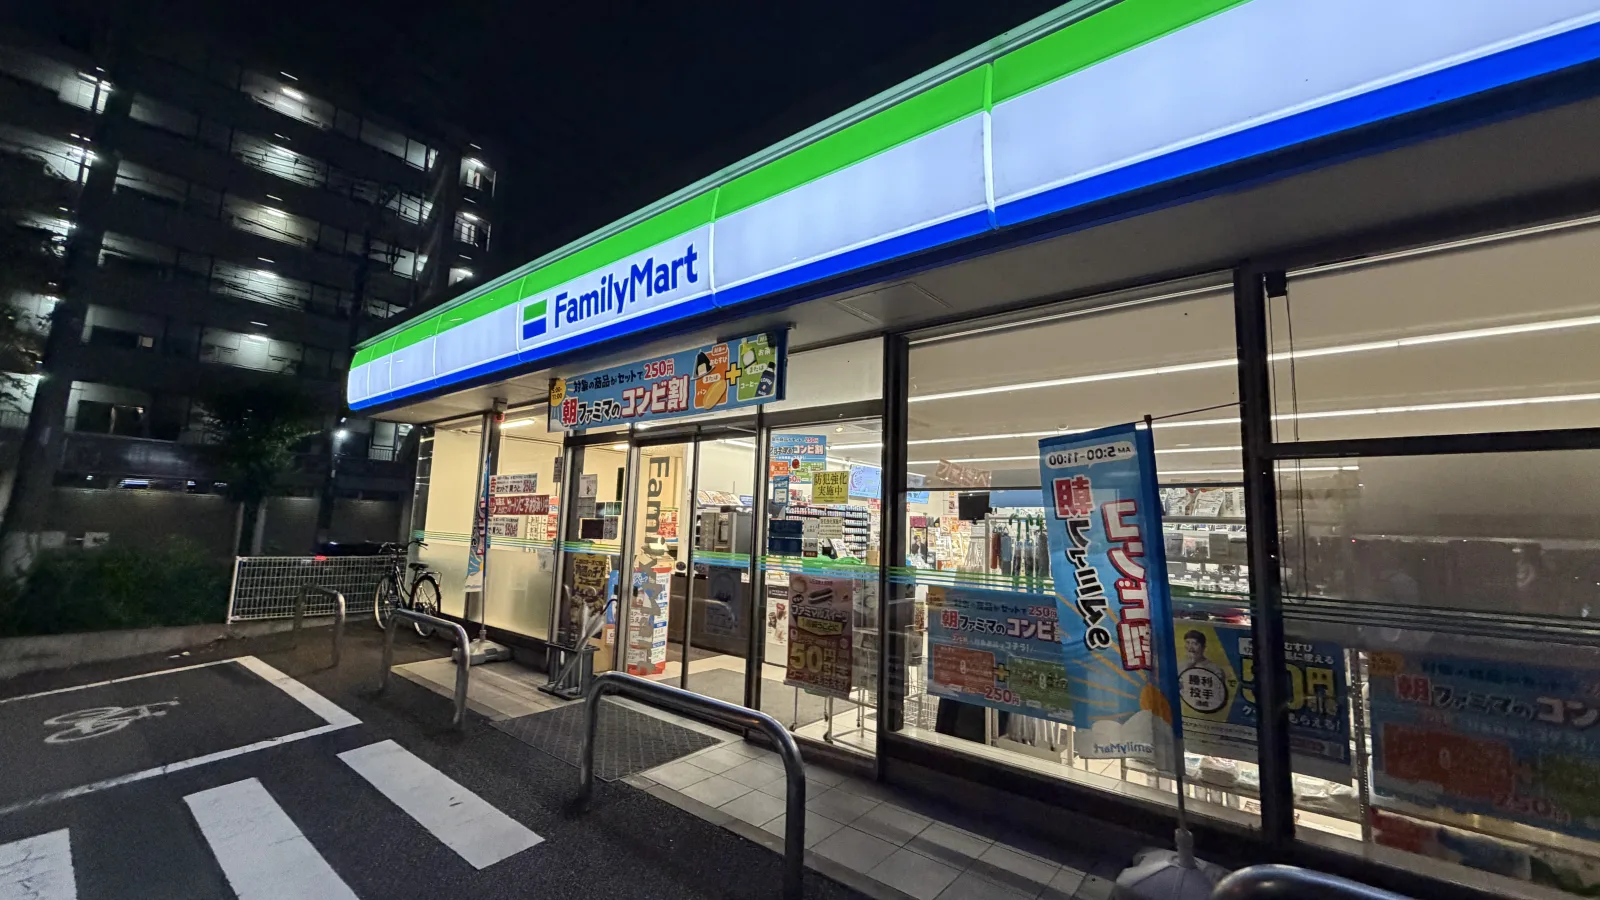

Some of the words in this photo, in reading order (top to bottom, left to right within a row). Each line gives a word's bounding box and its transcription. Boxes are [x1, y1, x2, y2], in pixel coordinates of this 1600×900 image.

[555, 243, 698, 329] FamilyMart
[758, 347, 771, 356] お茶
[750, 365, 765, 373] または
[705, 374, 719, 382] または
[740, 381, 759, 389] コーヒー
[697, 388, 707, 396] パン
[562, 375, 690, 427] 朝ファミマのコンビ割
[813, 471, 848, 485] 防犯強化
[818, 485, 843, 496] 実施中
[1228, 679, 1237, 688] で
[984, 686, 1021, 706] 250円
